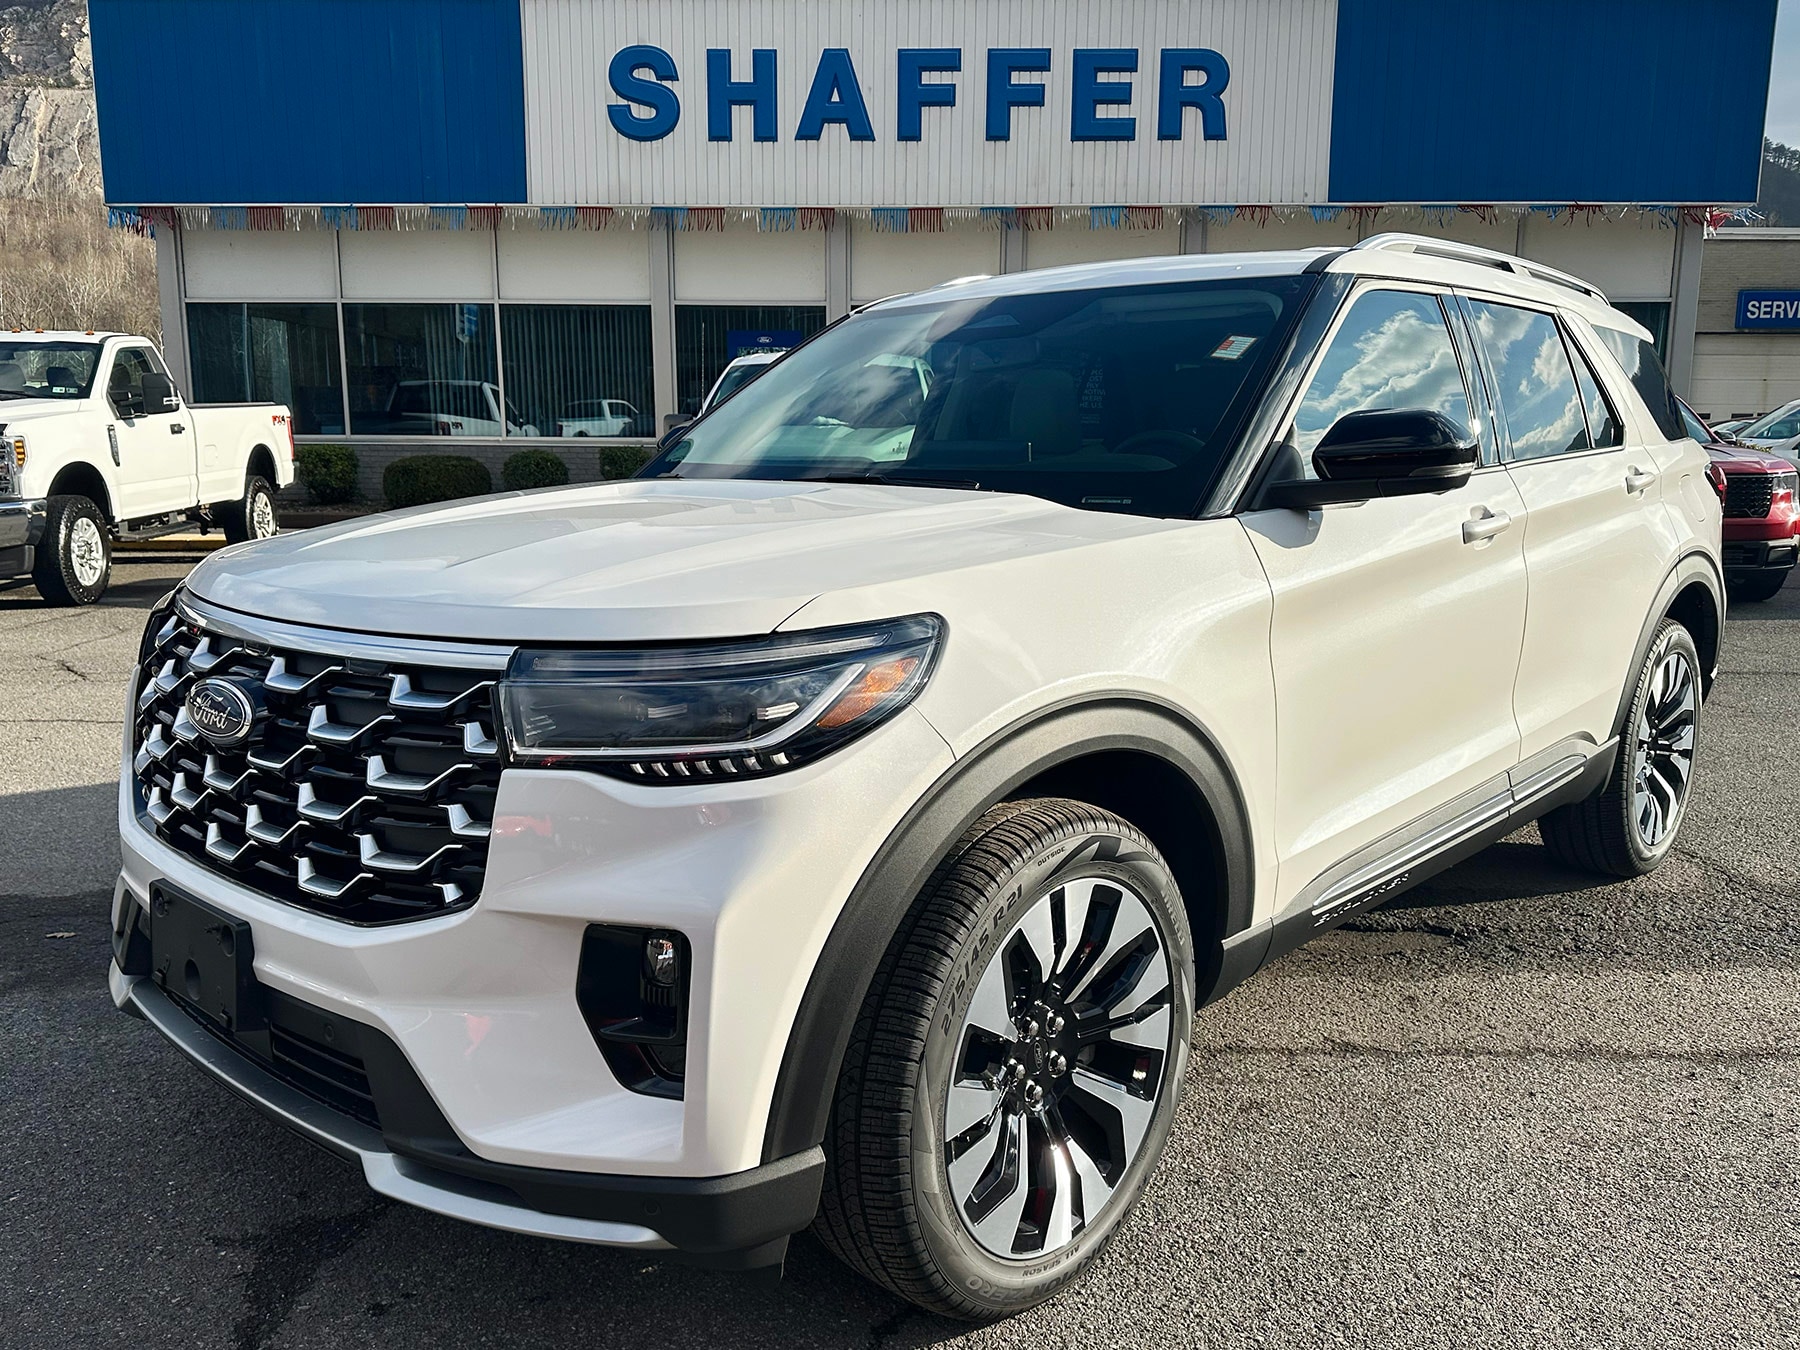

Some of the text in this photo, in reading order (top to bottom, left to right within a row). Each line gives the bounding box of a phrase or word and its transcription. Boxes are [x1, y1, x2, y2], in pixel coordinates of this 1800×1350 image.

[607, 44, 1231, 142] SHAFFER
[193, 690, 231, 729] Ford
[1037, 846, 1066, 867] OUTSIDE
[941, 928, 990, 1037] 275/45
[993, 884, 1023, 928] R21
[1022, 1244, 1081, 1277] ALL SEASON
[965, 1274, 1026, 1301] ZERO
